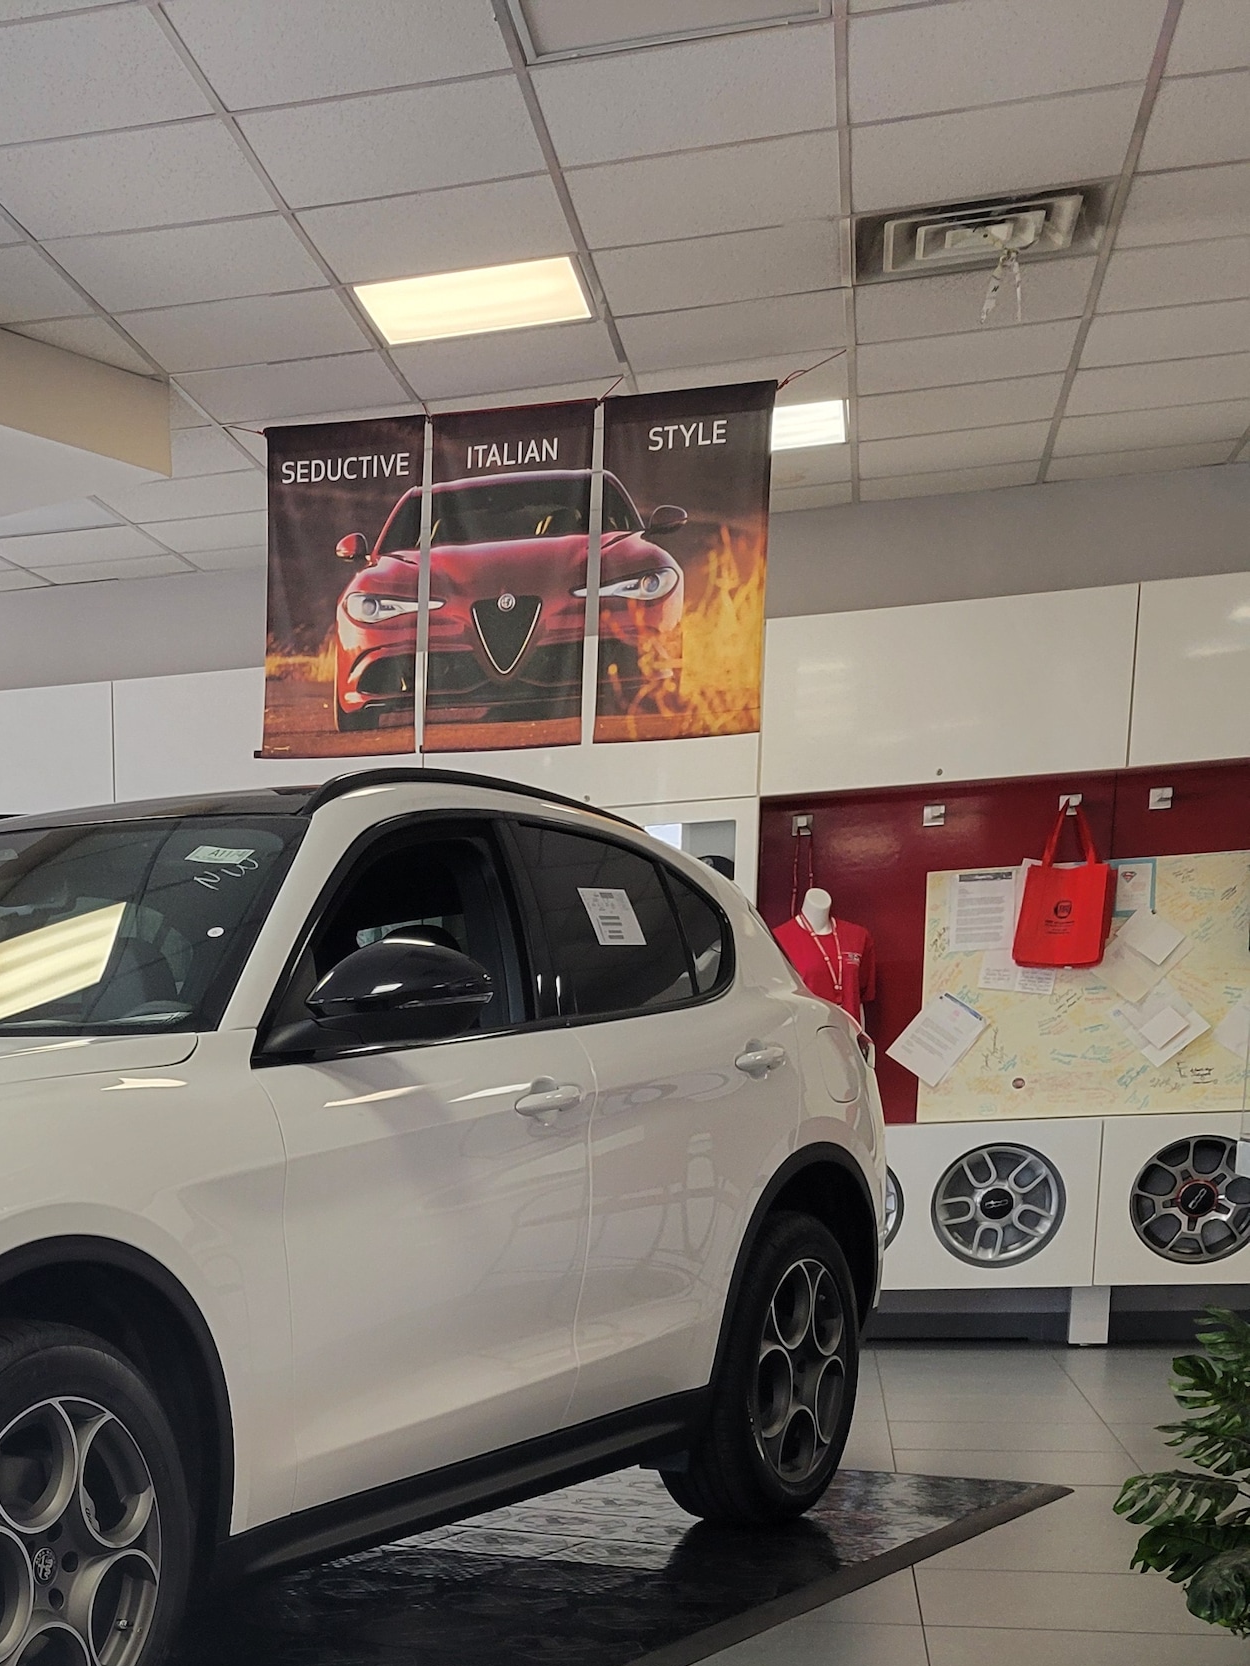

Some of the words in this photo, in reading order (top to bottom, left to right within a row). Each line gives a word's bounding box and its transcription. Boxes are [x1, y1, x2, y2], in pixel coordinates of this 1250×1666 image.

[649, 420, 728, 451] STYLE
[281, 452, 410, 484] SEDUCTIVE
[467, 437, 559, 469] ITALIAN
